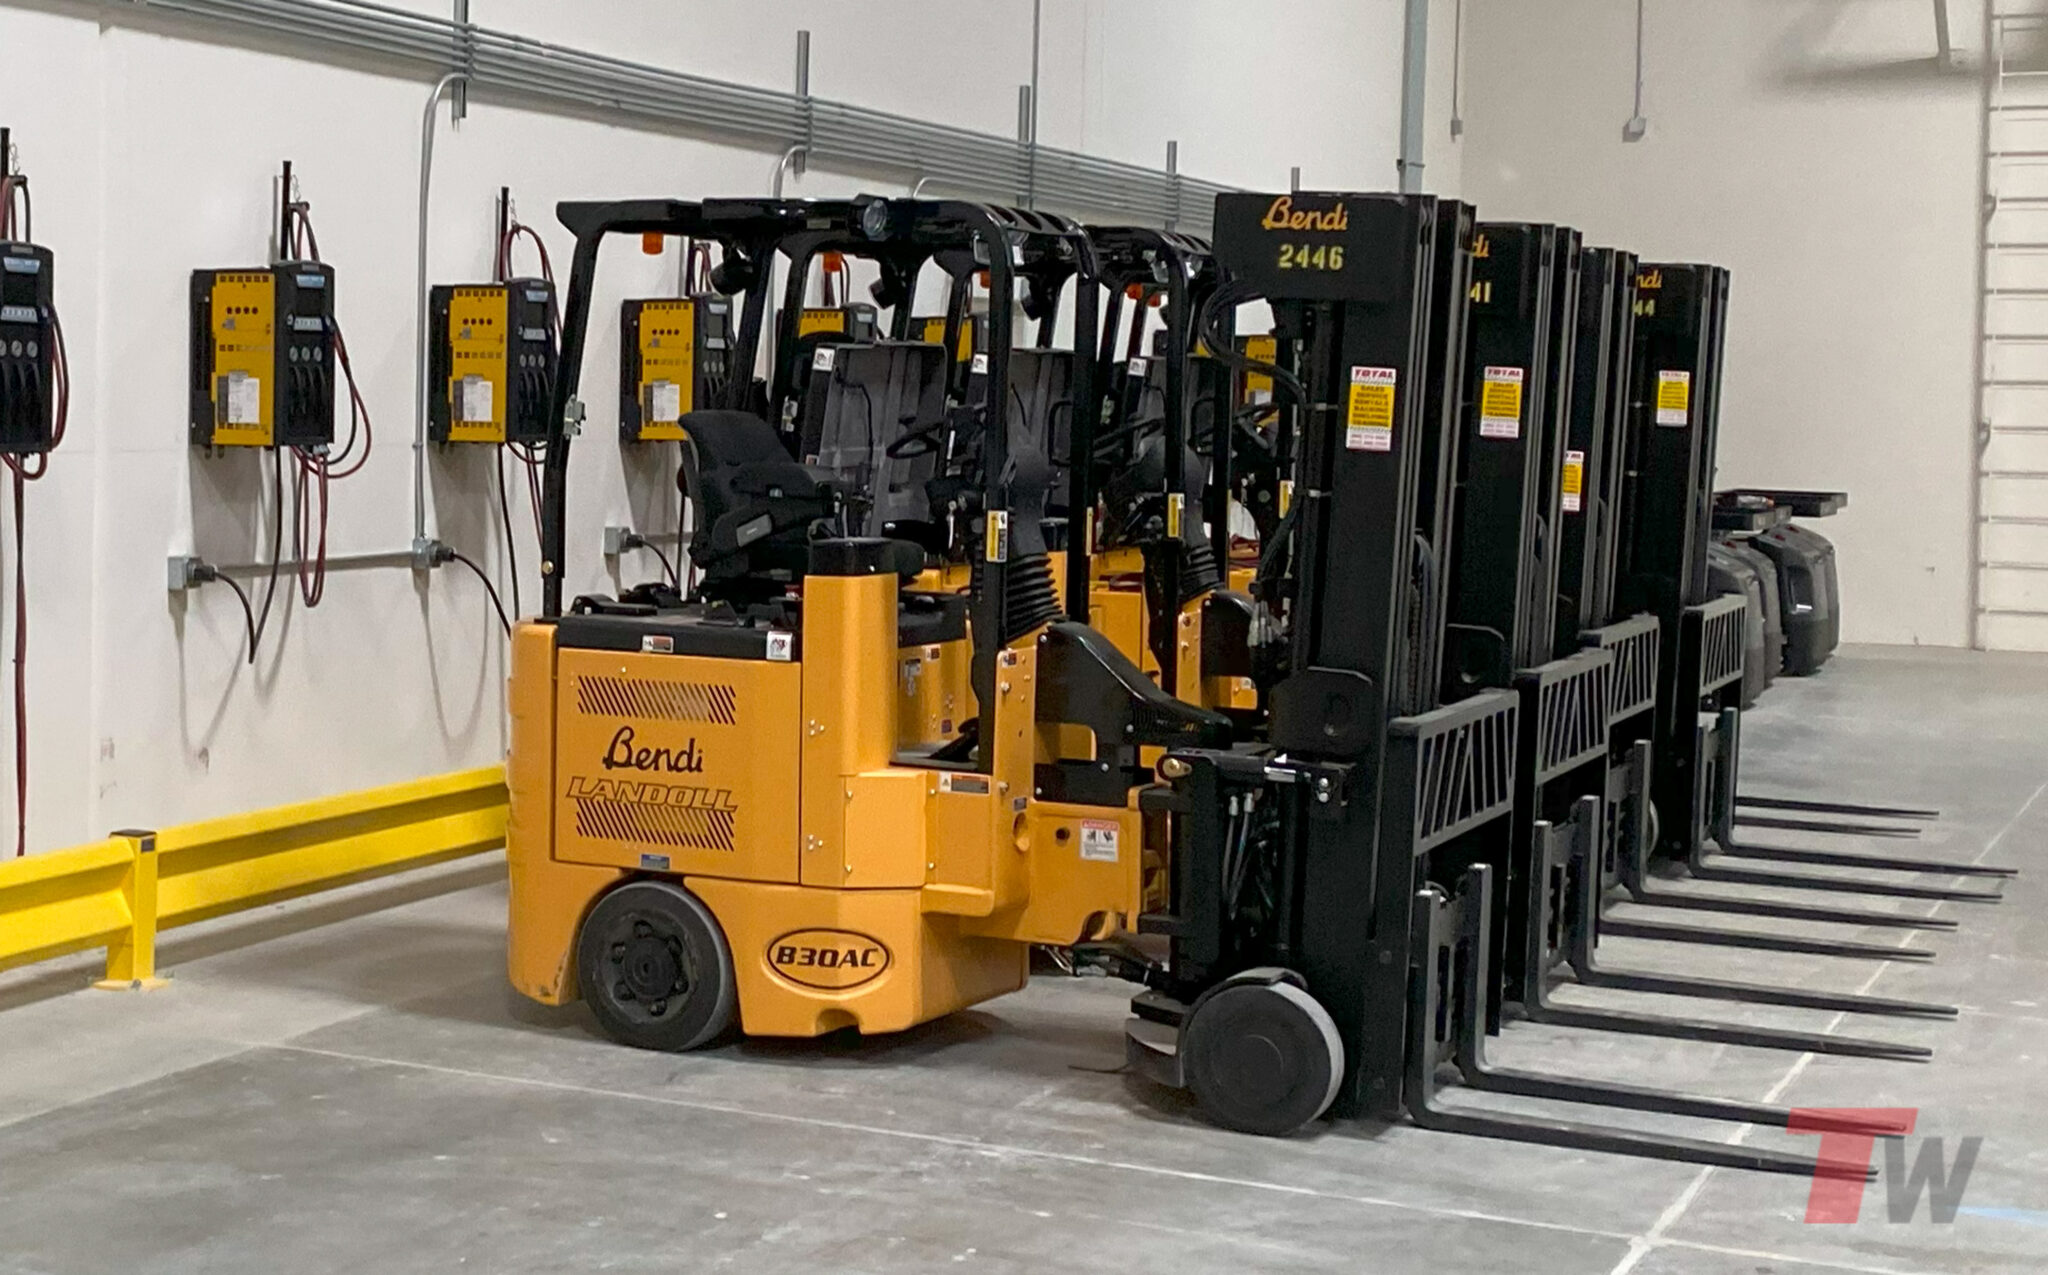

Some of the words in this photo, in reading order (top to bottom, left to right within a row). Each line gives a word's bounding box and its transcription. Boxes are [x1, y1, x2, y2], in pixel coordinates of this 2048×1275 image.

[1261, 196, 1348, 230] Bendi
[1278, 244, 1344, 270] 2446
[1636, 269, 1662, 288] ndi
[1469, 281, 1491, 303] 41
[1631, 299, 1656, 316] 44
[1354, 369, 1393, 378] TOTAL
[602, 725, 704, 773] Bendi
[565, 776, 739, 813] LANDOLL
[775, 946, 878, 968] B30AC
